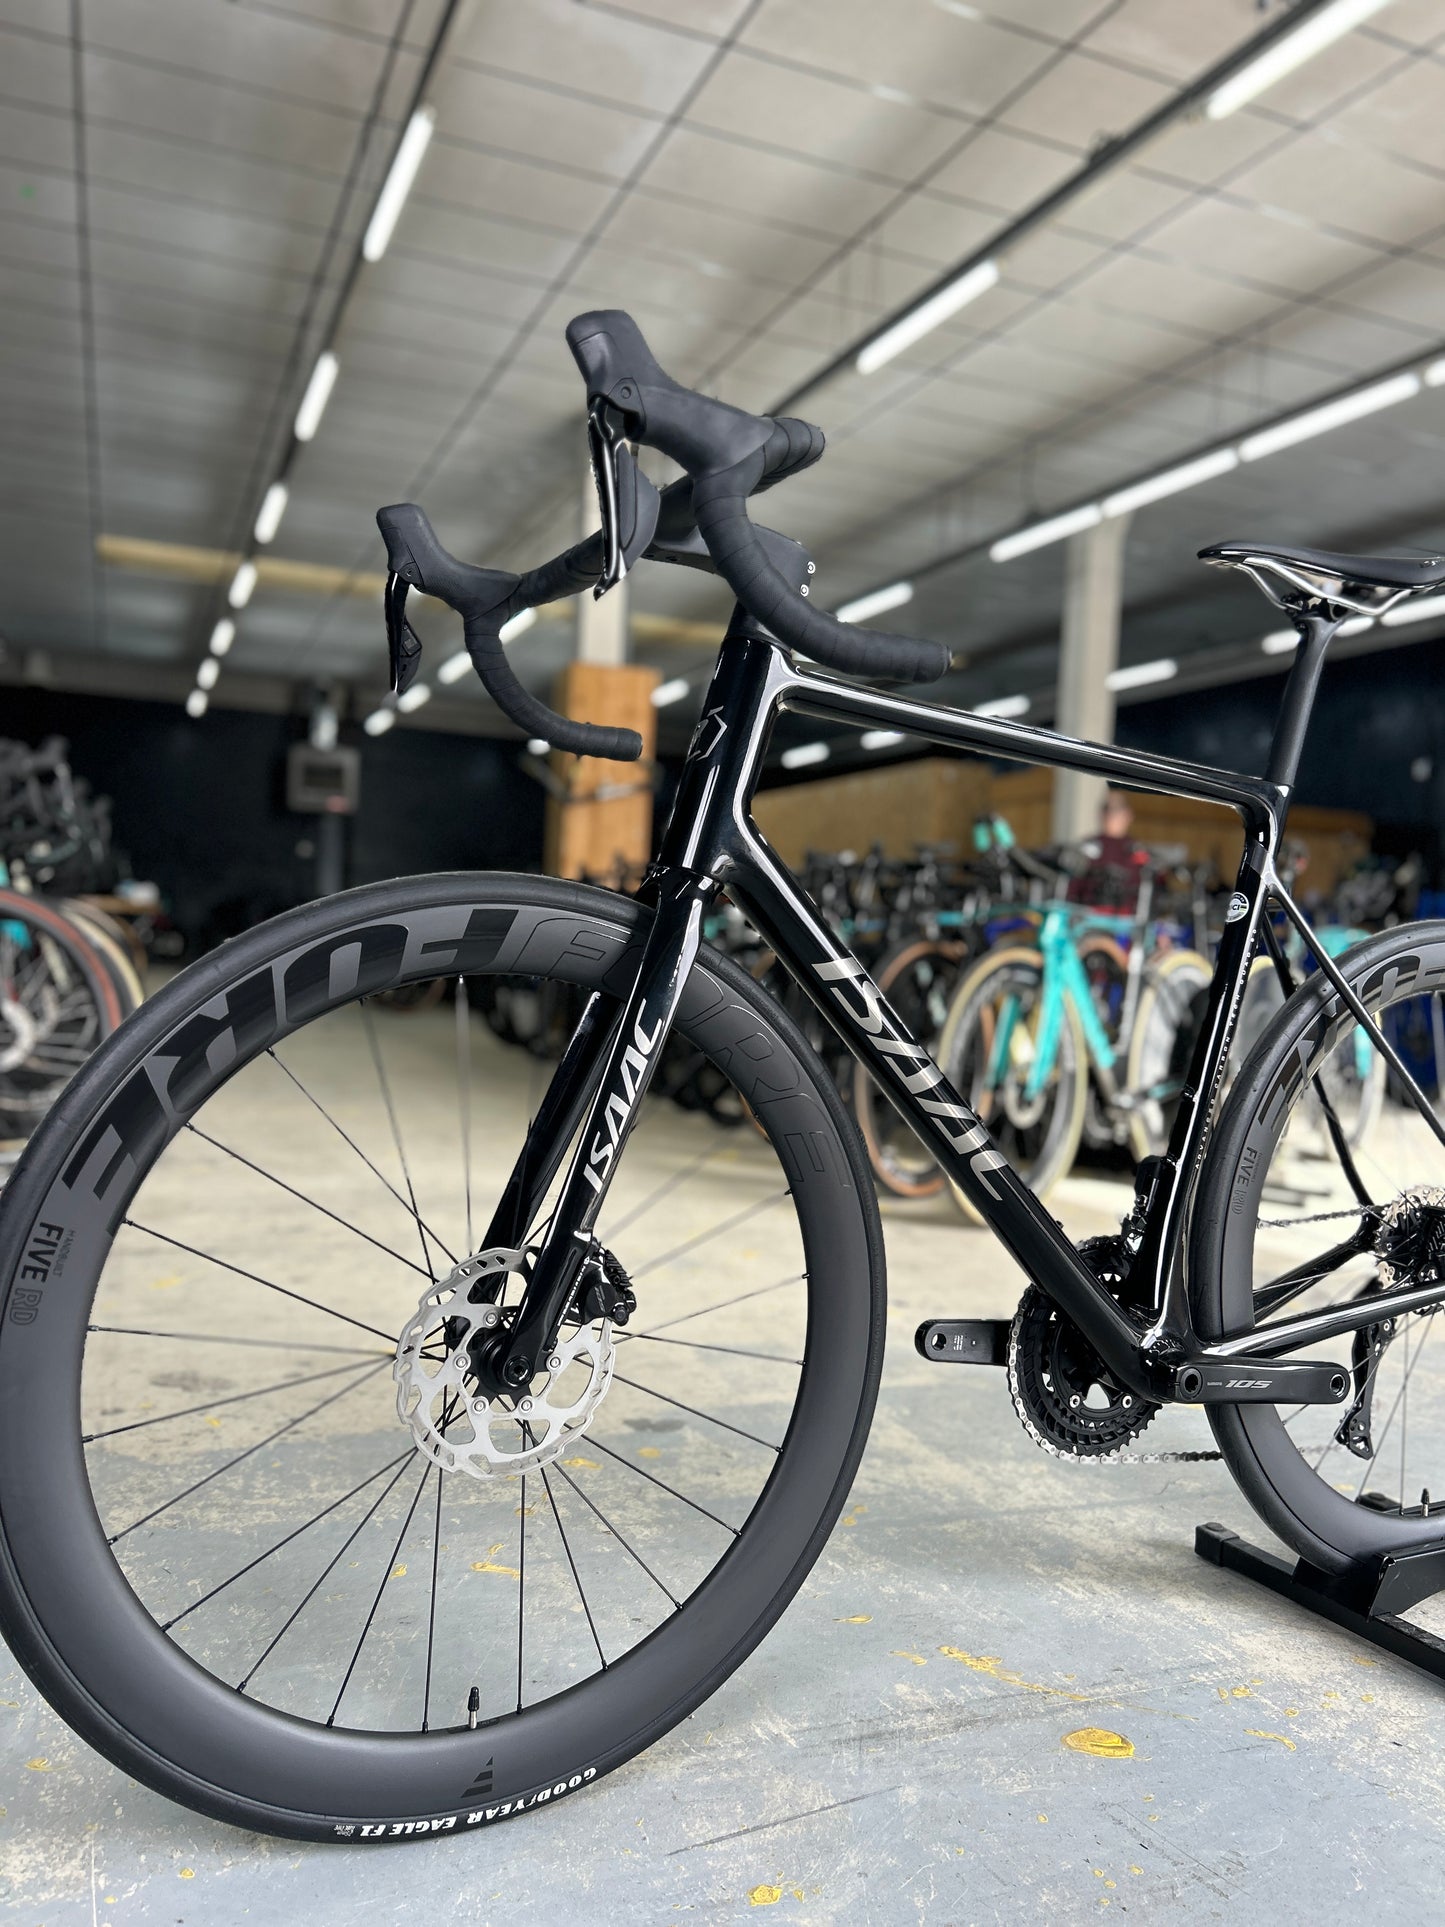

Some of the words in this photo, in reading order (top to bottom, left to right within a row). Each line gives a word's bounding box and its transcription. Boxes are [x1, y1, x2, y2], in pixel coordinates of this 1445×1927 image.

[811, 957, 1008, 1200] ISAAC
[1214, 1036, 1231, 1090] CARBON
[583, 998, 665, 1193] ISAAC
[1237, 1146, 1258, 1187] FIVE
[21, 1222, 64, 1283] FIVE
[9, 1288, 43, 1326] RD
[1225, 1380, 1273, 1389] 105
[467, 1767, 597, 1825] GOODYEAR
[389, 1816, 457, 1835] EAGLE
